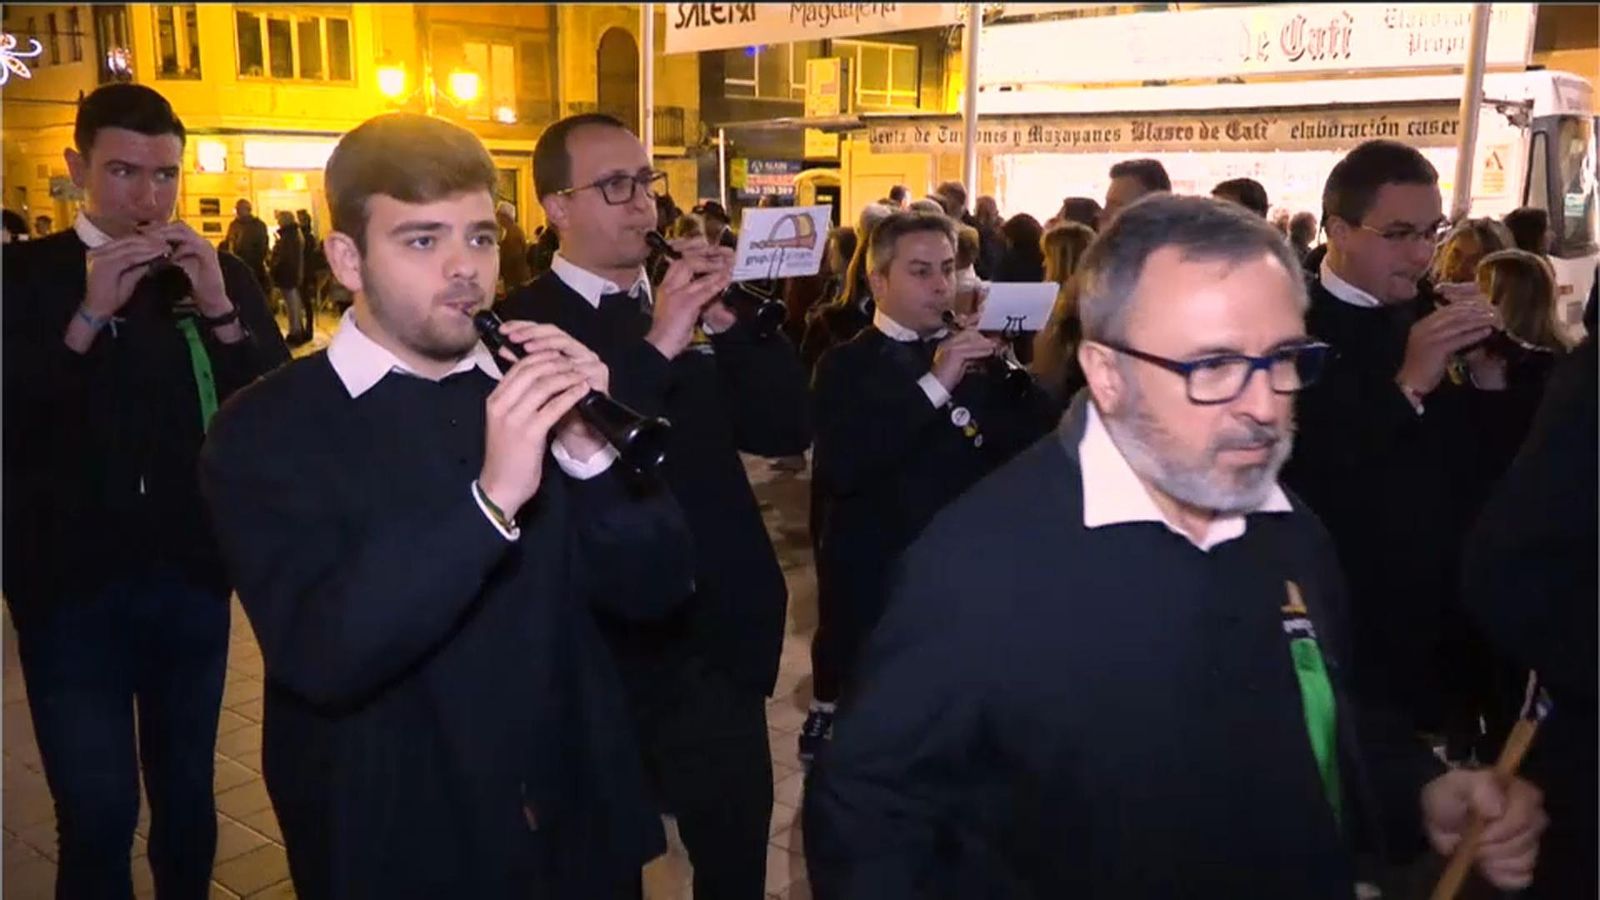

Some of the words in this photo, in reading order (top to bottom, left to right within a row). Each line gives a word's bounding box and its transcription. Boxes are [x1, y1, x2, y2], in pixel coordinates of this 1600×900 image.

[914, 125, 931, 143] de
[1013, 129, 1022, 147] y
[1027, 125, 1121, 147] Mazapanes
[1131, 120, 1194, 141] Blasco
[1200, 120, 1220, 140] de
[1290, 115, 1399, 139] elaboración
[1407, 119, 1459, 136] caser
